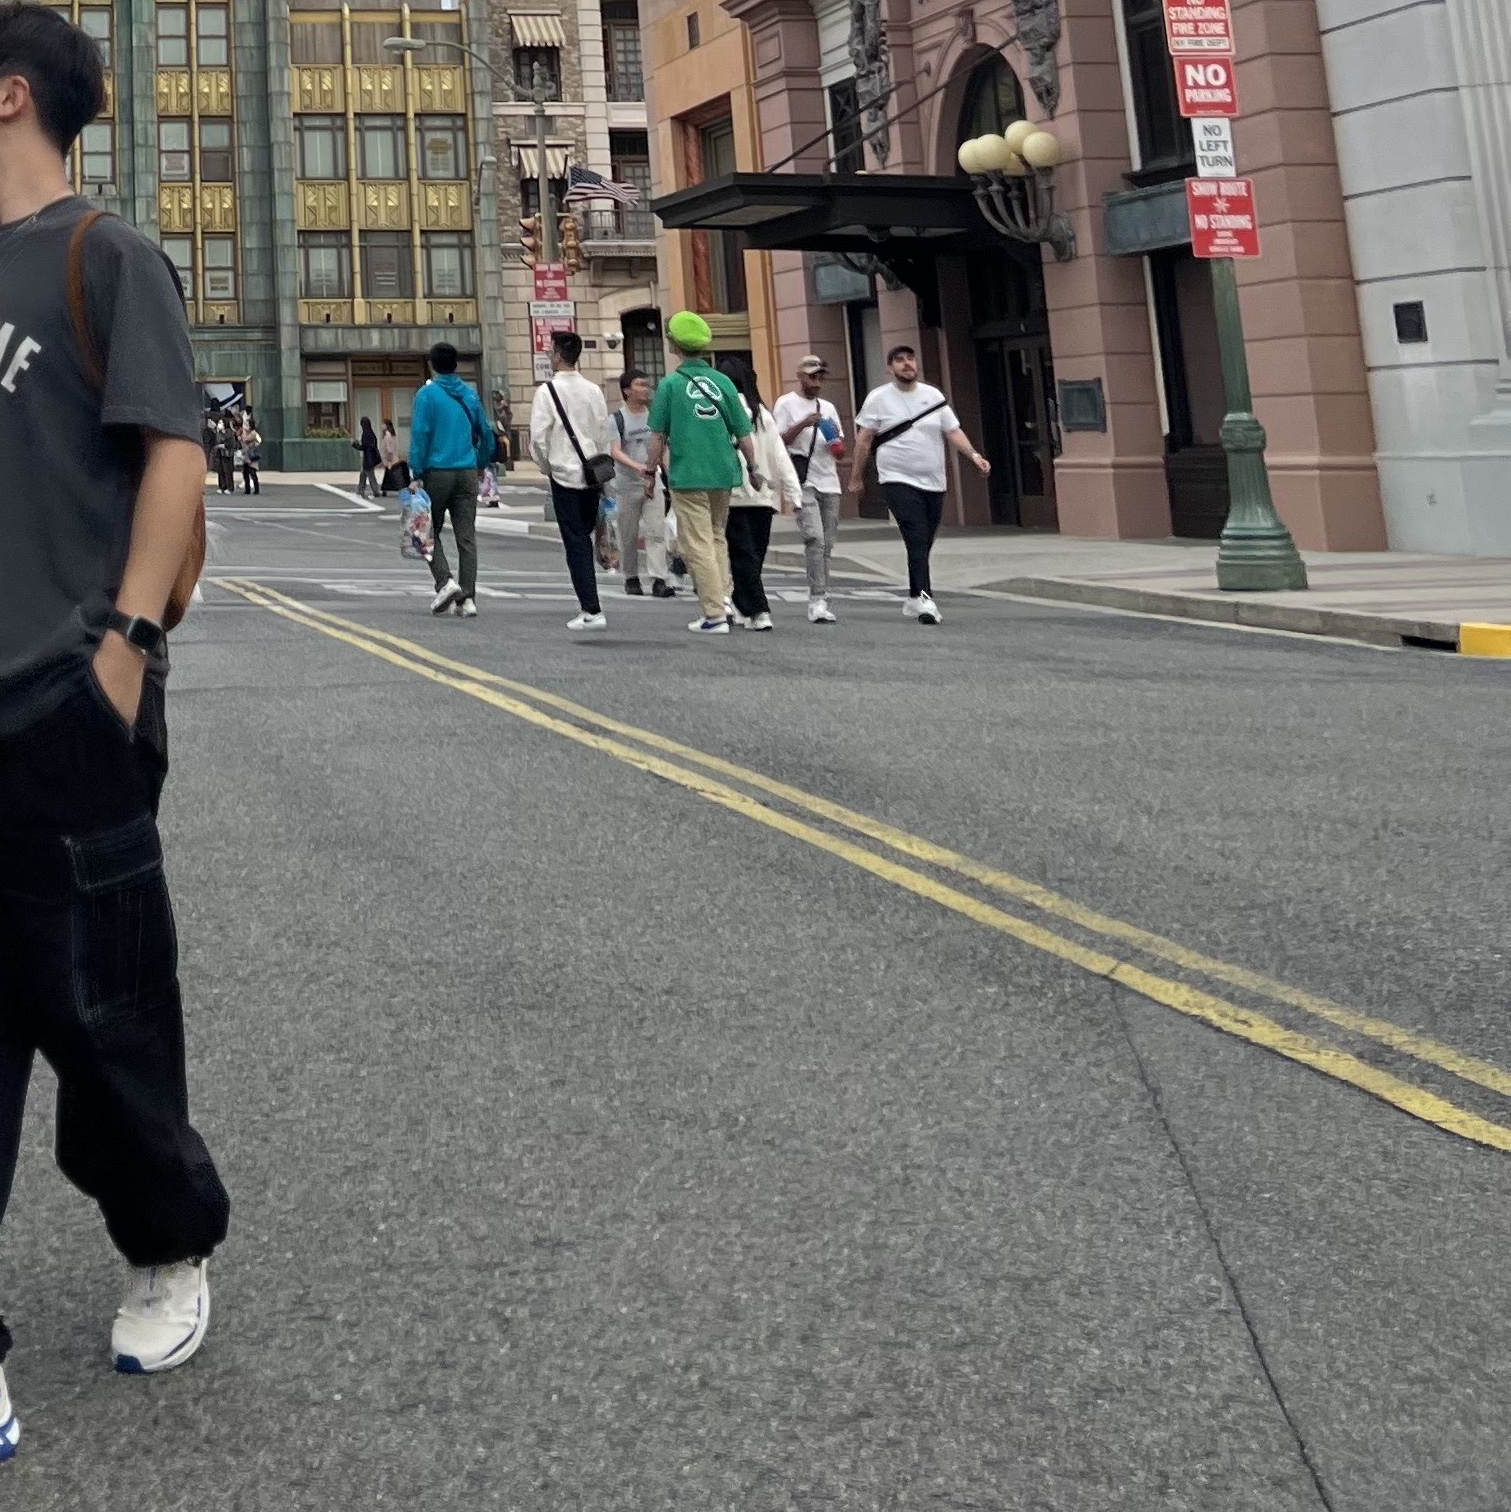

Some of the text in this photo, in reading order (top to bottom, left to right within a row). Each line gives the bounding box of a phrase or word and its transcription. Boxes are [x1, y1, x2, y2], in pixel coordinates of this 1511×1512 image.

[1168, 6, 1226, 20] STANDING
[1172, 22, 1227, 35] FIRE ZONE
[1184, 63, 1227, 87] NO
[1184, 88, 1232, 104] PARKING
[1202, 124, 1223, 137] NO
[1199, 140, 1230, 153] LEFT
[1198, 155, 1233, 168] TURN
